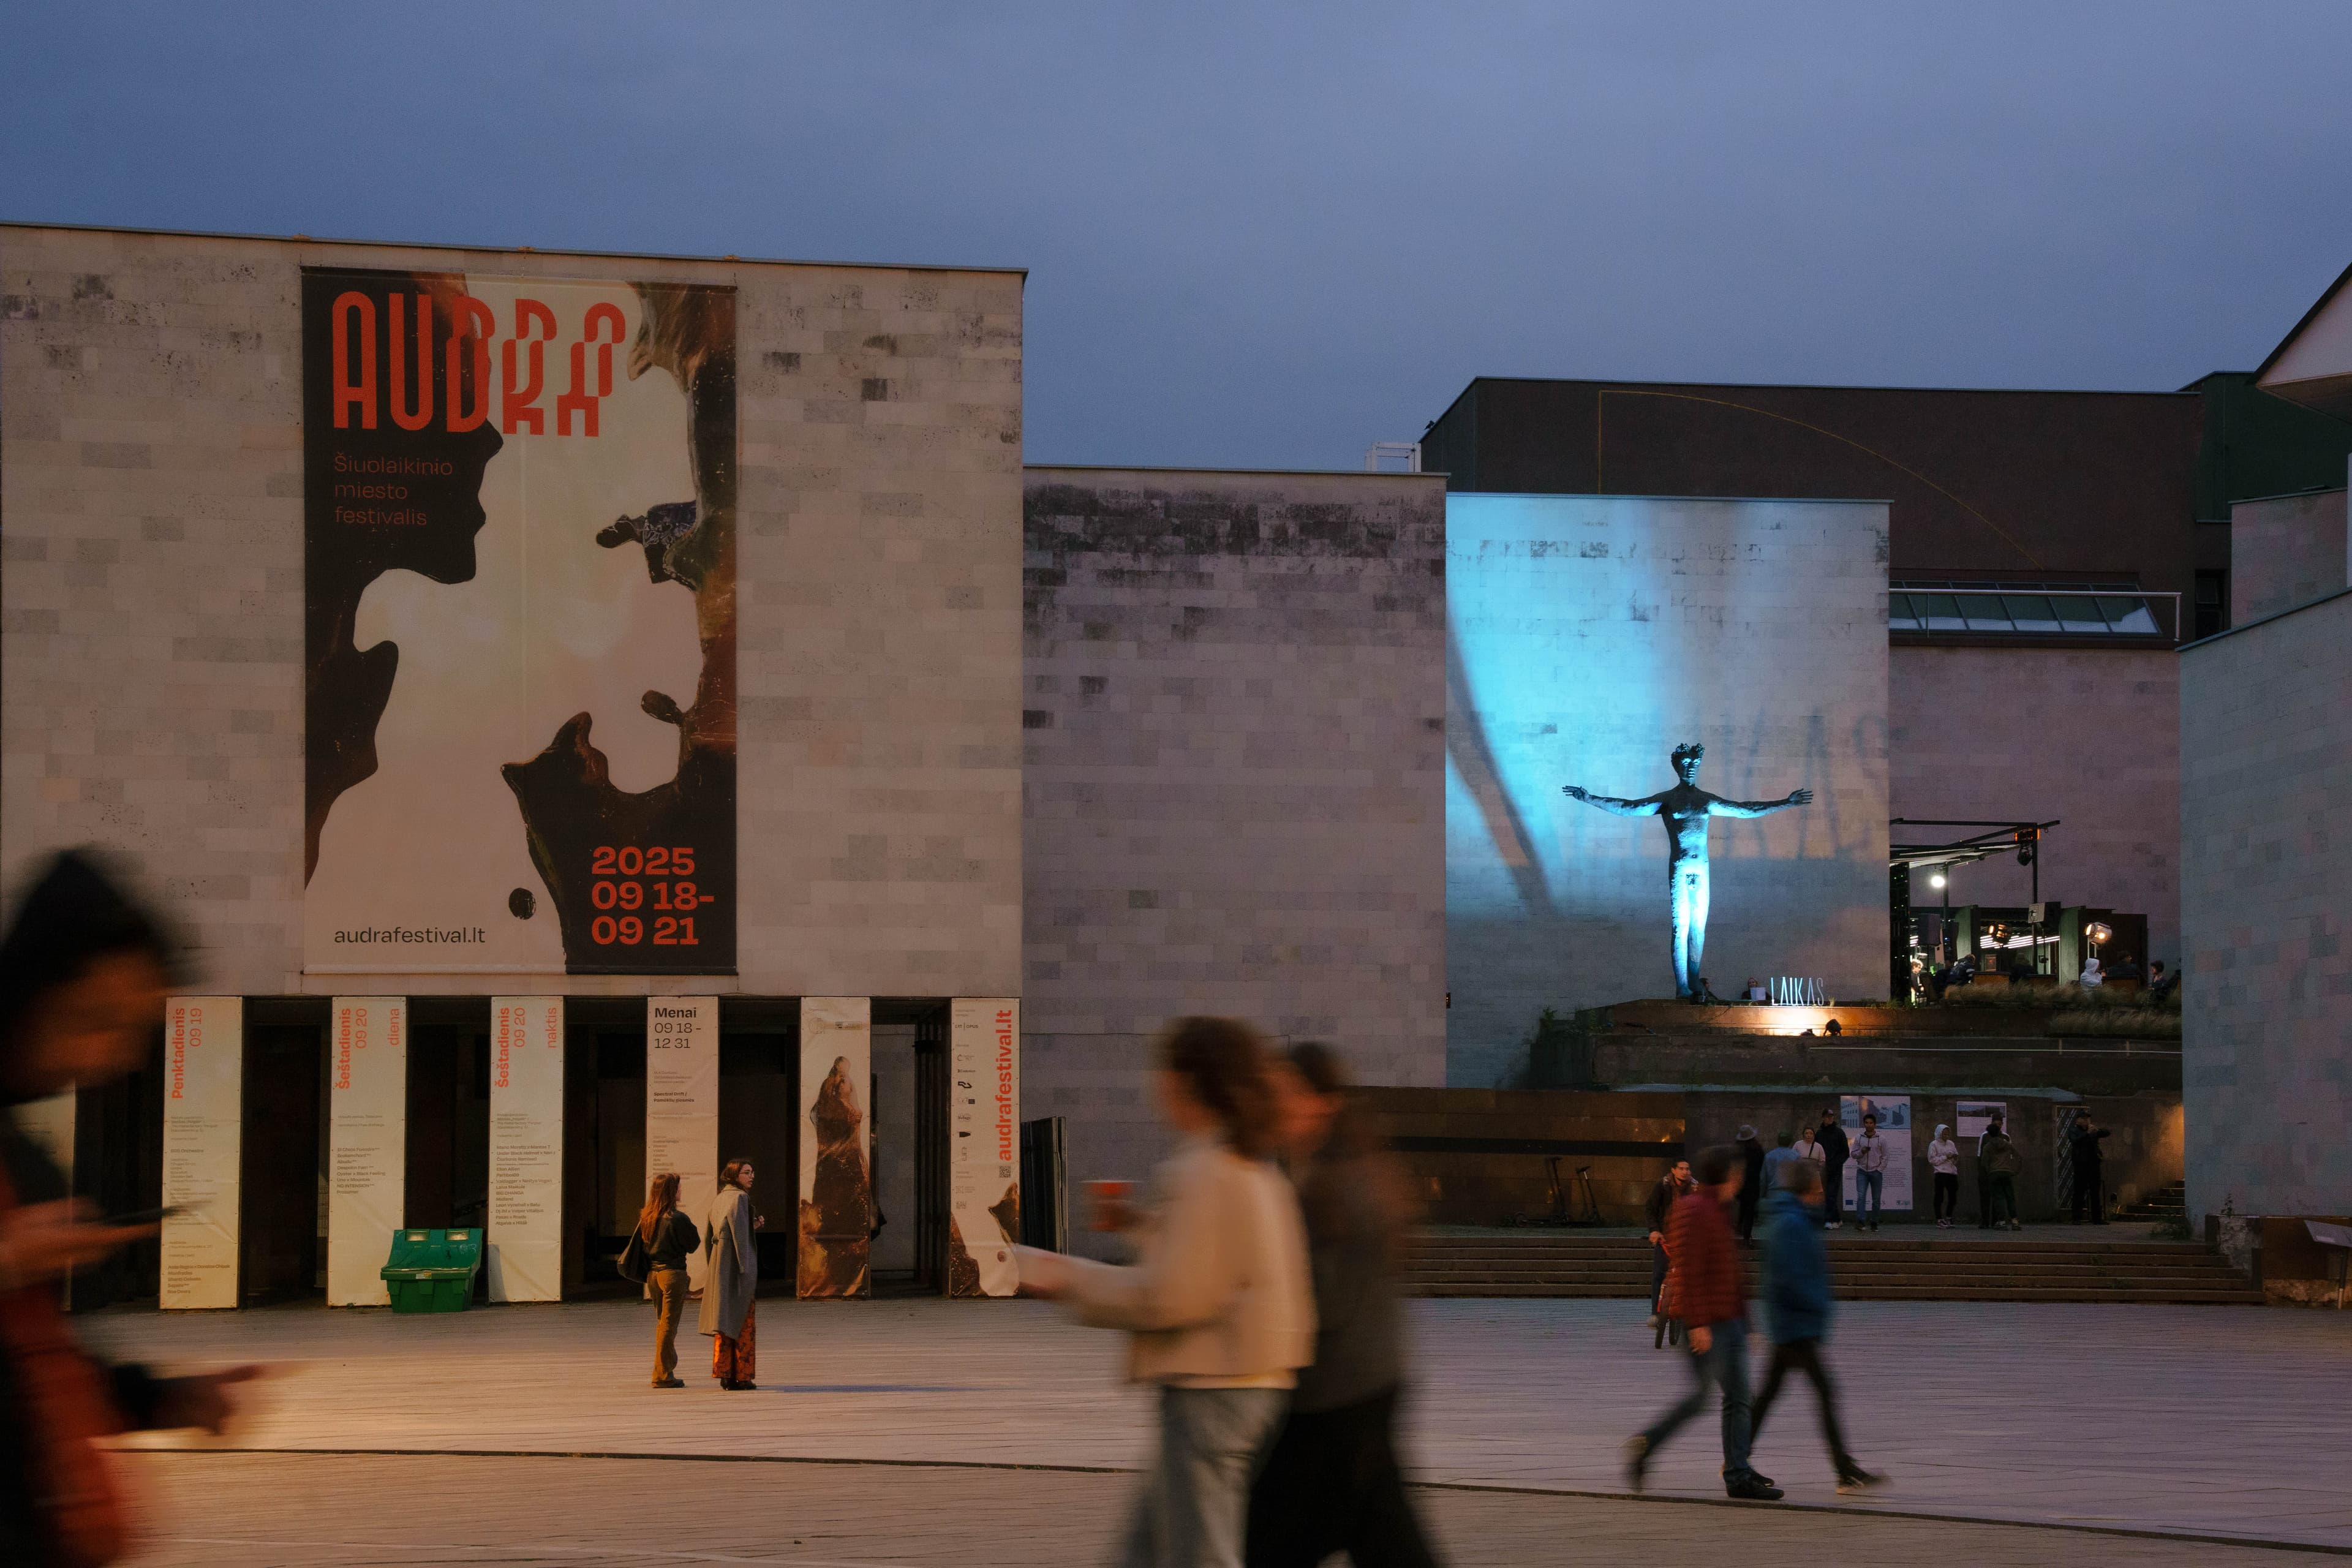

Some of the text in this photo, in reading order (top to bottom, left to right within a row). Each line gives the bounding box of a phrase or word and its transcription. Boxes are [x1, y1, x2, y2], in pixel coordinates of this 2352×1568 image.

[332, 291, 626, 437] AUDRA
[334, 452, 453, 477] Šiuolaikinio
[334, 482, 408, 501] miesto
[334, 505, 428, 527] festivalis
[592, 846, 696, 875] 2025
[592, 881, 643, 910] 09
[334, 926, 485, 944] audrafestival.lt
[592, 916, 698, 946] 09 21
[190, 1008, 202, 1047] 09 19
[356, 1008, 368, 1049] 09 20
[388, 1008, 399, 1046] diena
[514, 1007, 526, 1049] 09 20
[545, 1007, 557, 1049] naktis
[654, 1023, 673, 1034] 09
[676, 1023, 692, 1034] 18
[655, 1008, 697, 1018] Menai
[172, 1008, 185, 1099] Penktadienis
[335, 1008, 350, 1090] Šeštadienis
[494, 1007, 510, 1088] Šeštadienis
[654, 1038, 691, 1049] 12 31
[995, 1010, 1012, 1161] audrafestival.lt
